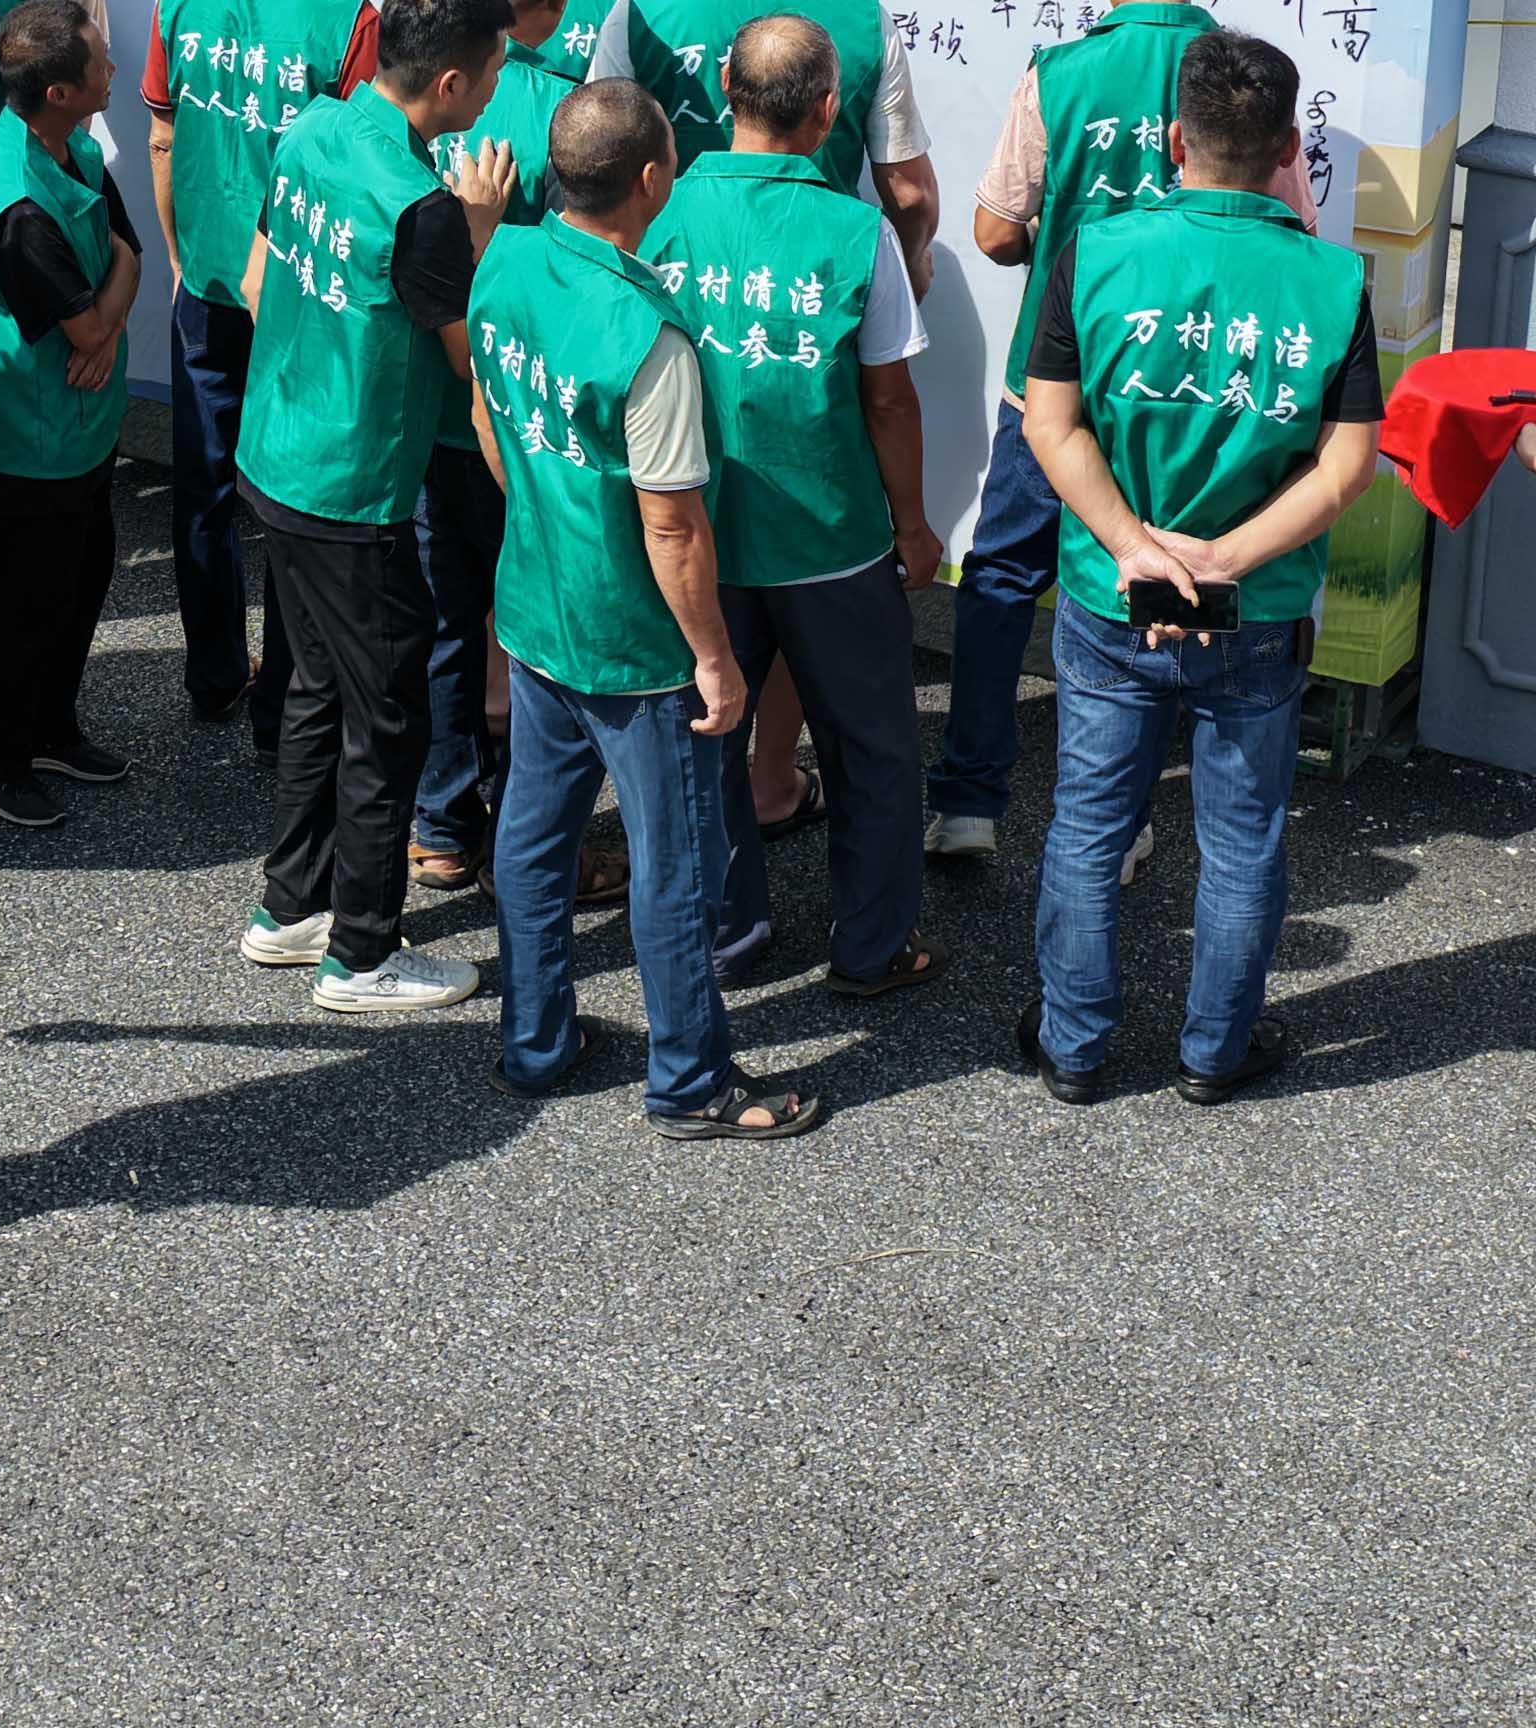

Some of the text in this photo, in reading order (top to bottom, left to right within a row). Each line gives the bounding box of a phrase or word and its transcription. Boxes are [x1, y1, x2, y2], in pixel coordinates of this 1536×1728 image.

[178, 32, 307, 93] 万村清洁
[562, 22, 597, 59] 村
[273, 175, 354, 263] 万村清洁
[267, 229, 348, 312] 人人参与
[659, 260, 825, 317] 万村清洁
[1123, 309, 1313, 370] 万村清洁
[481, 322, 578, 420] 万村清洁
[1120, 371, 1299, 424] 人人参与
